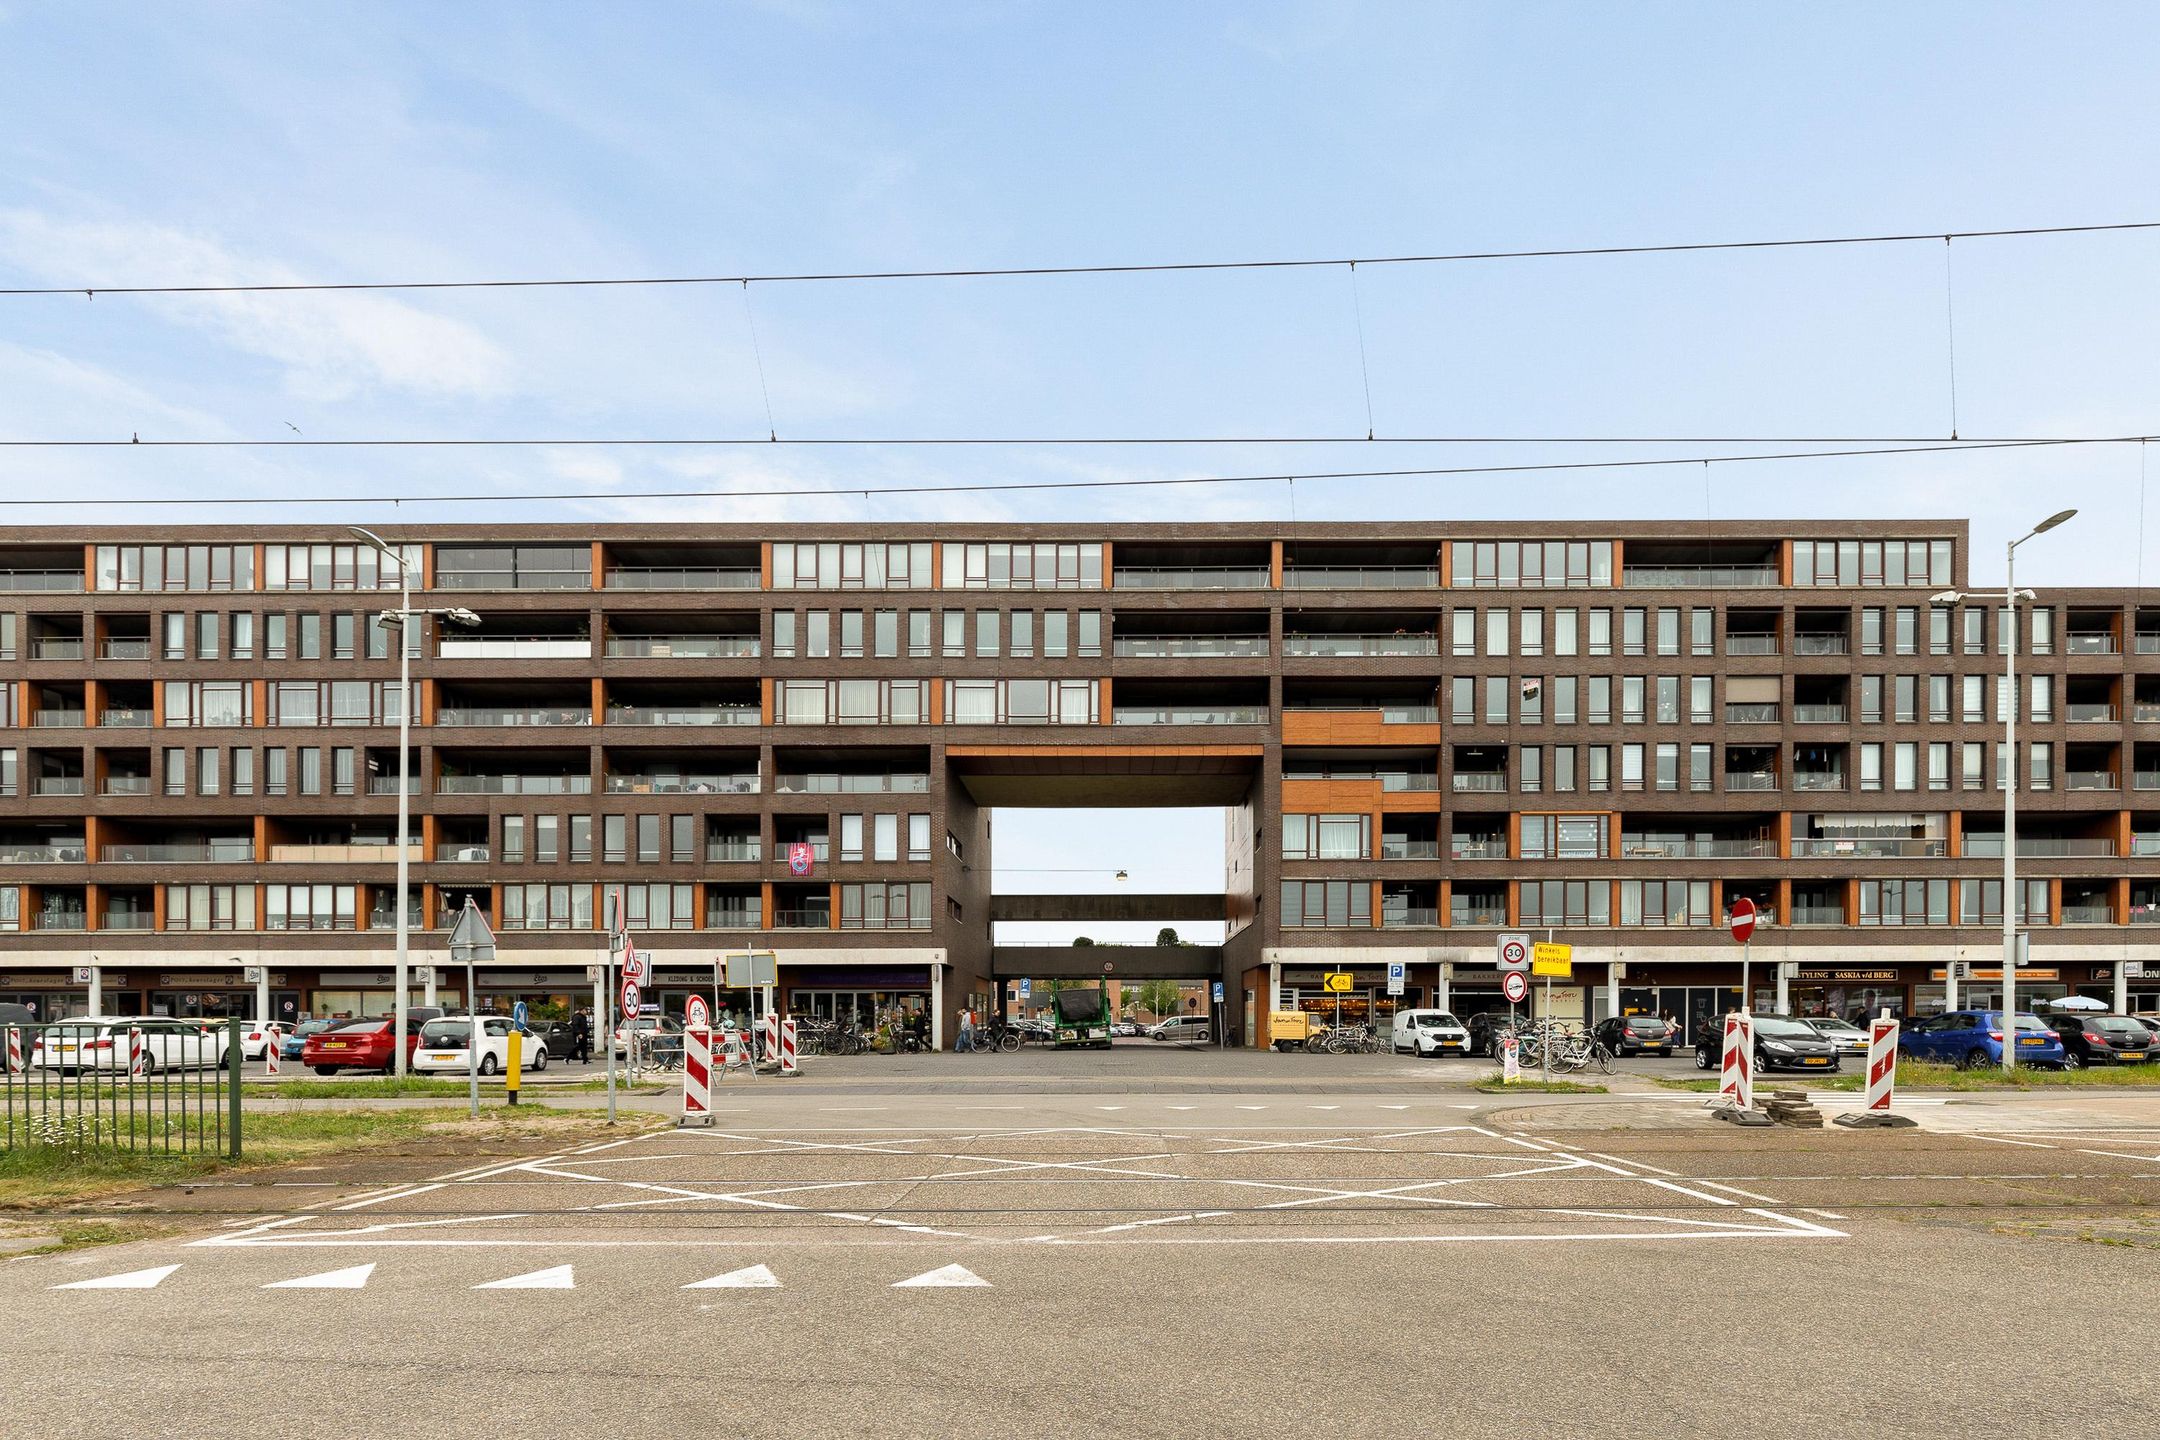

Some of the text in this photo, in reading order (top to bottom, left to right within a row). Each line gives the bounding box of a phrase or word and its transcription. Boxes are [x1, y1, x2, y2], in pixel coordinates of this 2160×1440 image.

[1507, 948, 1522, 957] 30
[1538, 946, 1560, 954] Winkels
[1537, 956, 1569, 964] bereikbaar
[1835, 971, 1861, 979] SASKIA
[1873, 971, 1894, 979] BERG
[626, 992, 638, 1008] 30
